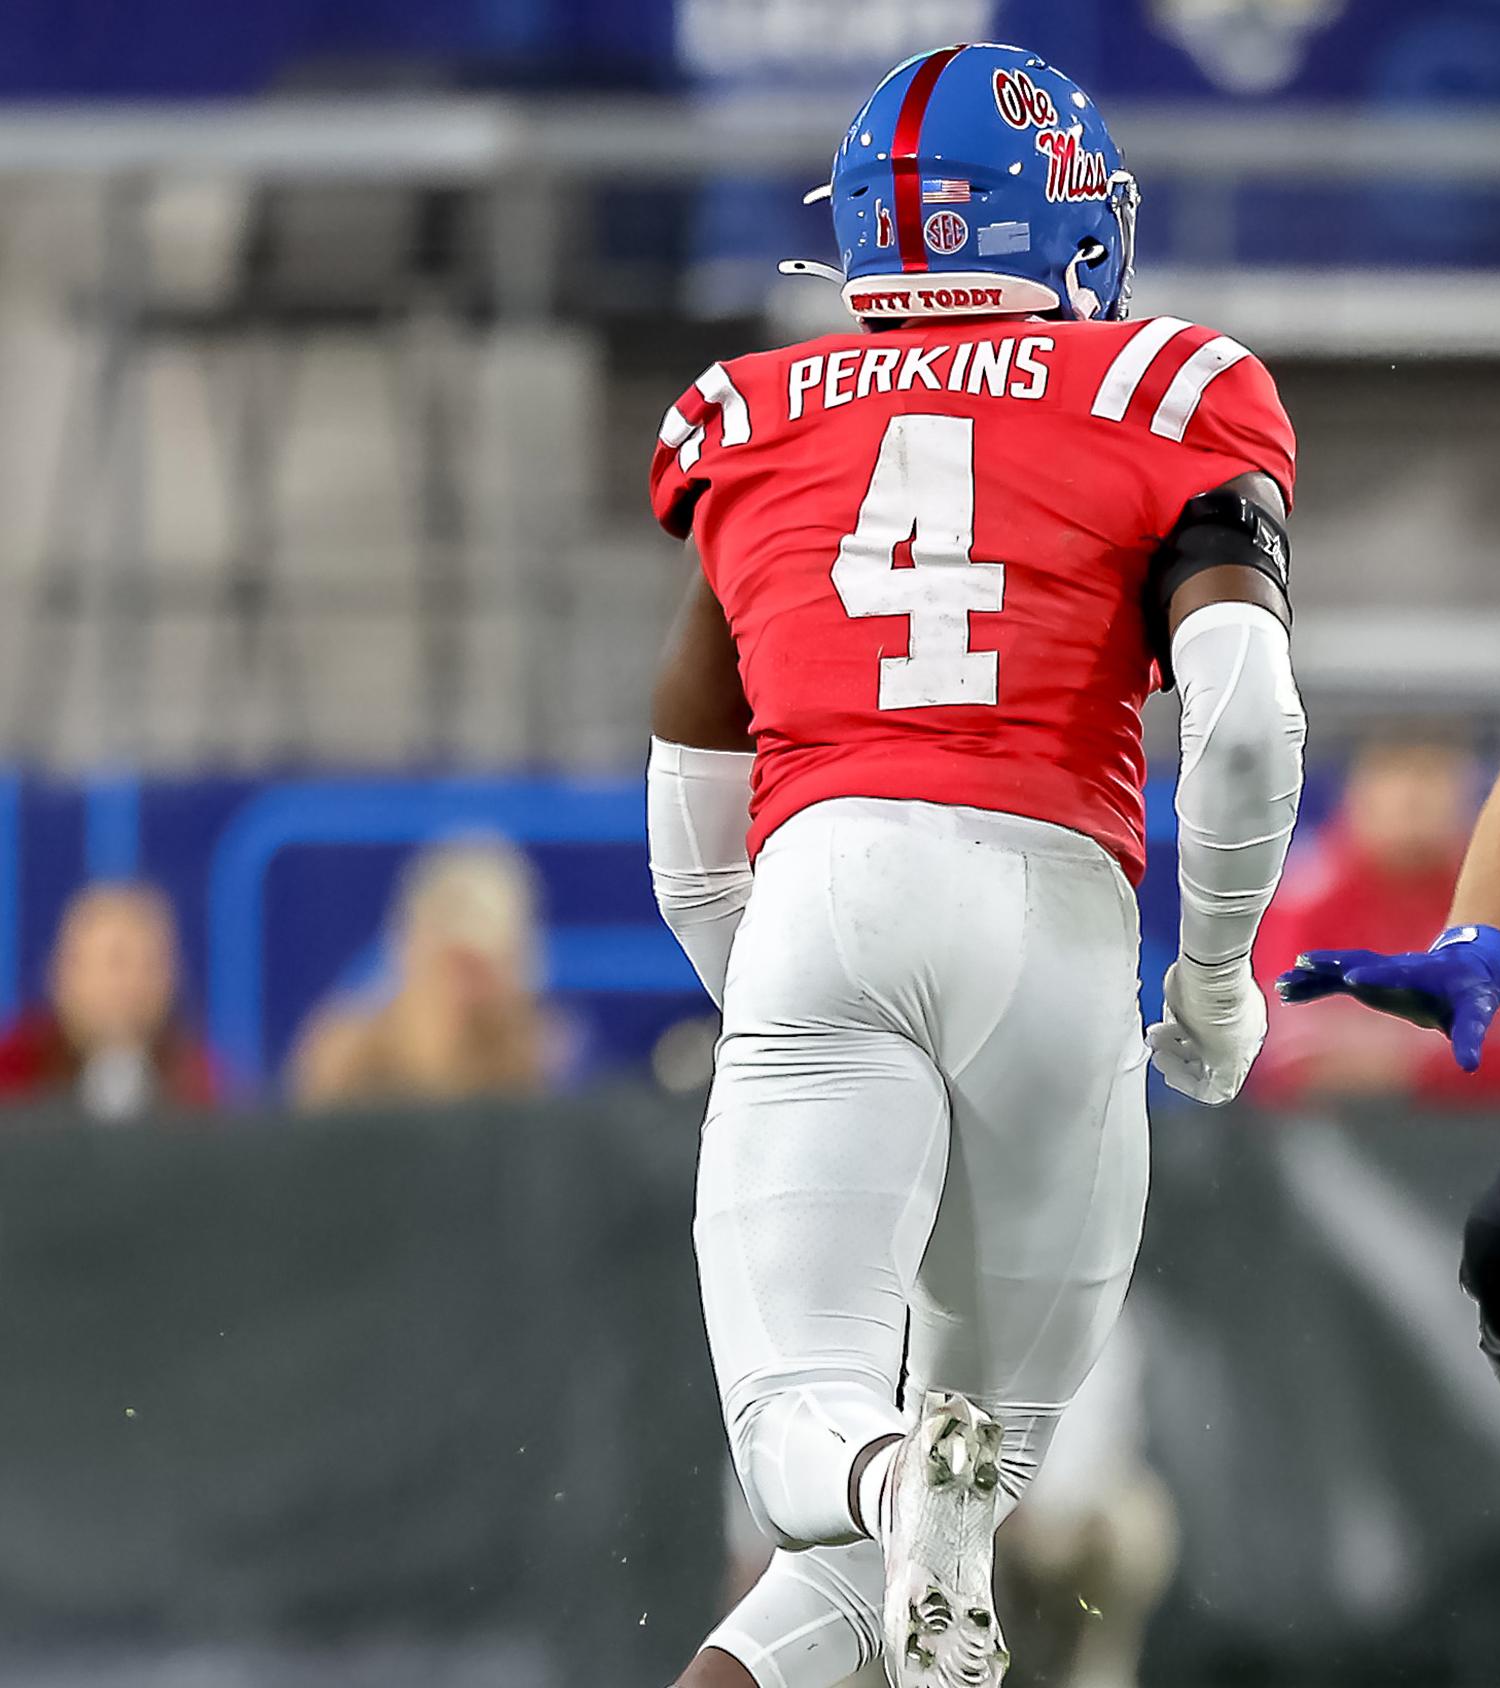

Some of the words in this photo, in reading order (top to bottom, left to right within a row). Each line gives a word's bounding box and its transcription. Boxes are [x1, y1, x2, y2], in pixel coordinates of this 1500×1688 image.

[993, 68, 1057, 129] Ole
[1036, 129, 1108, 203] Miss
[928, 219, 965, 249] SEC
[917, 288, 1002, 308] TODDY
[788, 337, 1054, 421] PERKINS
[832, 414, 1004, 711] 4
